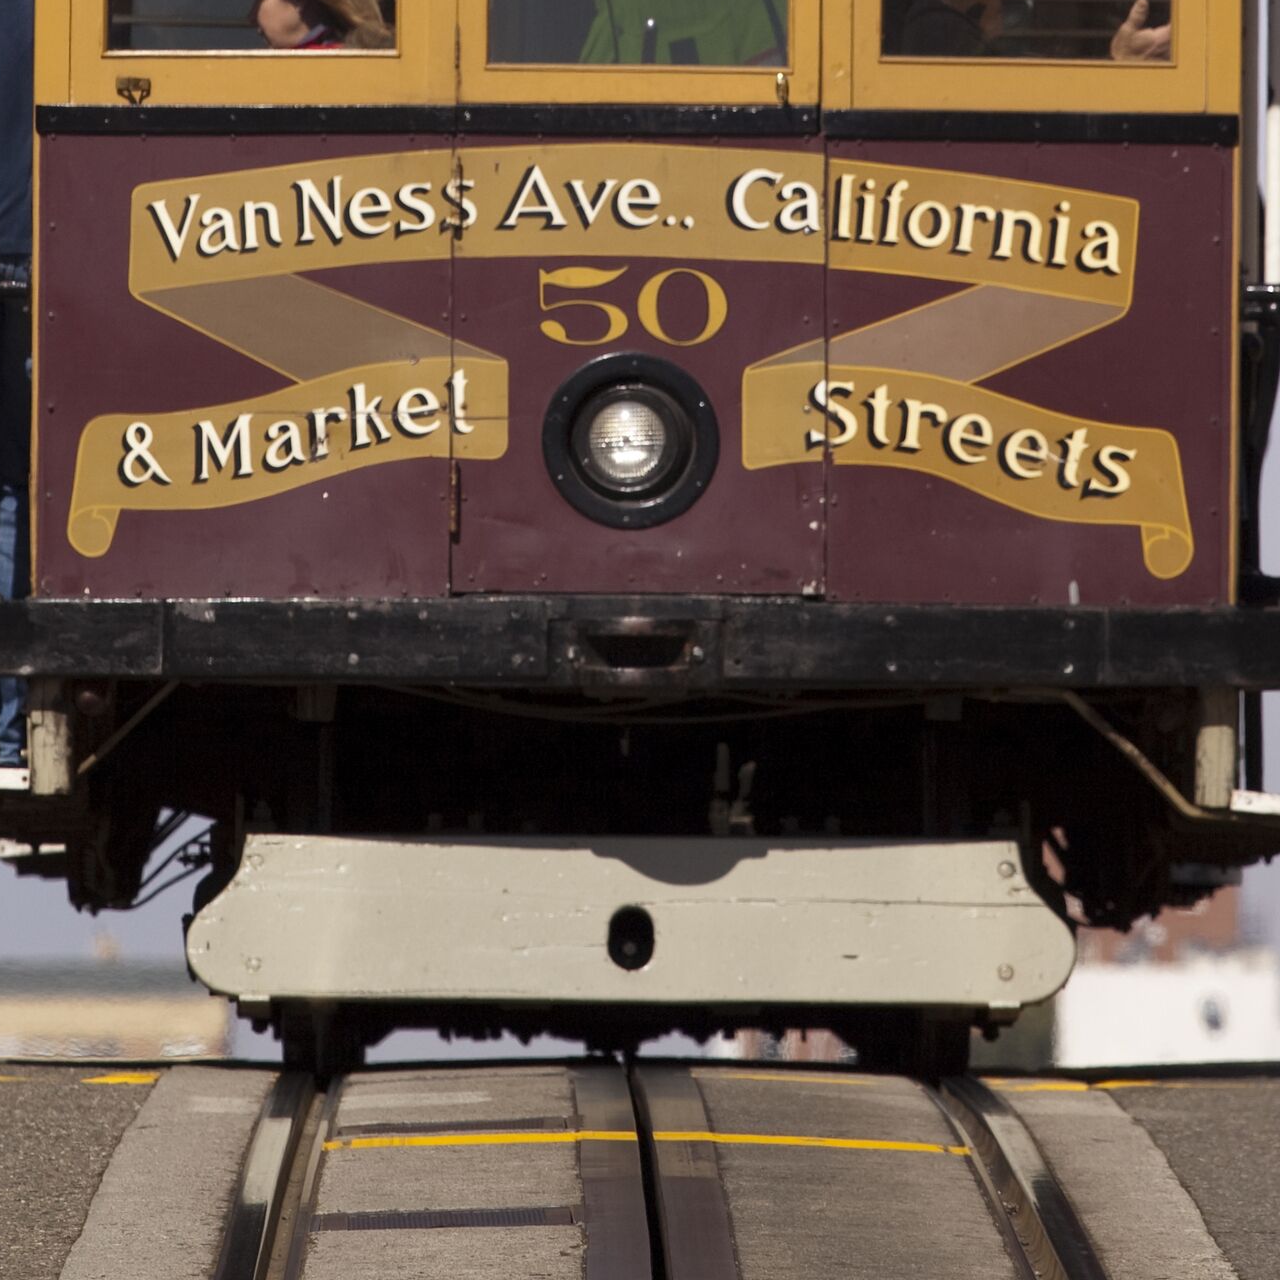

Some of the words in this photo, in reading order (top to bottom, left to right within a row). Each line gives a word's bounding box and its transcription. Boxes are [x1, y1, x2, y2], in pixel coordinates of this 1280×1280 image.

[149, 193, 282, 261] Van
[292, 175, 478, 246] Ness
[729, 167, 1122, 274] California
[538, 265, 728, 347] 50
[121, 421, 173, 486] &
[195, 367, 476, 482] Market
[808, 378, 1138, 497] Streets
